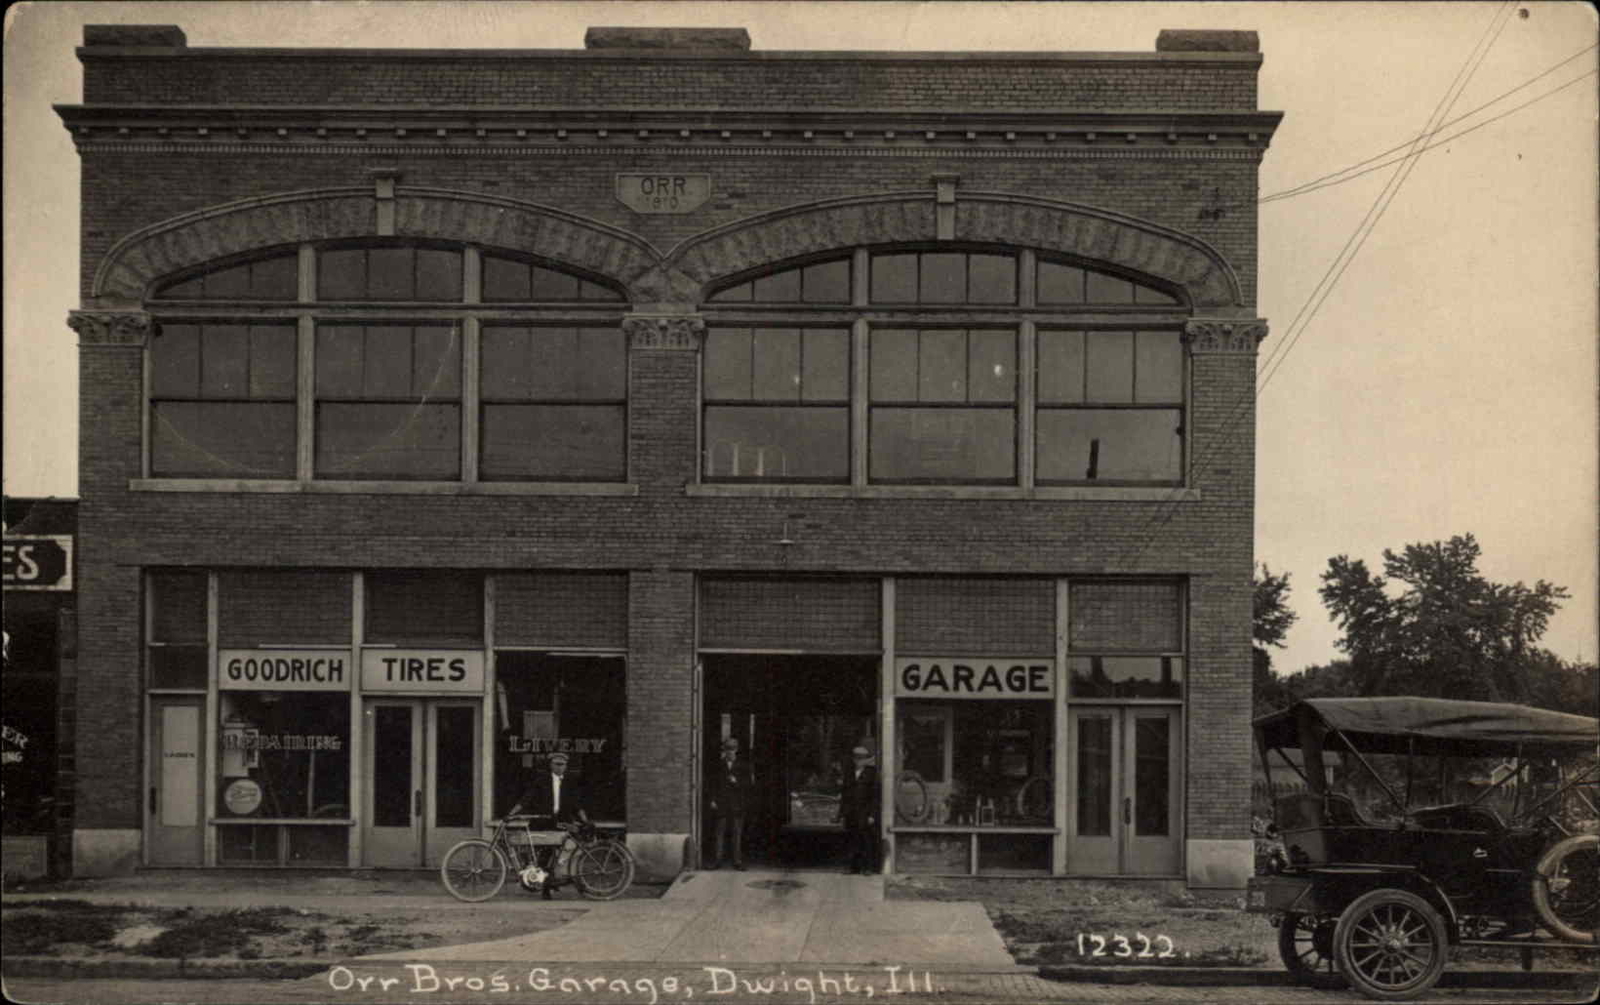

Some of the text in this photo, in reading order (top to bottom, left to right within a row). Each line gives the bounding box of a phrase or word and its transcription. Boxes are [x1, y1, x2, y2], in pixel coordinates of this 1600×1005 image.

[641, 177, 687, 196] ORR
[2, 545, 39, 580] ES
[227, 658, 343, 682] GOODRICH
[382, 658, 466, 682] TIRES
[901, 664, 1049, 692] GARAGE
